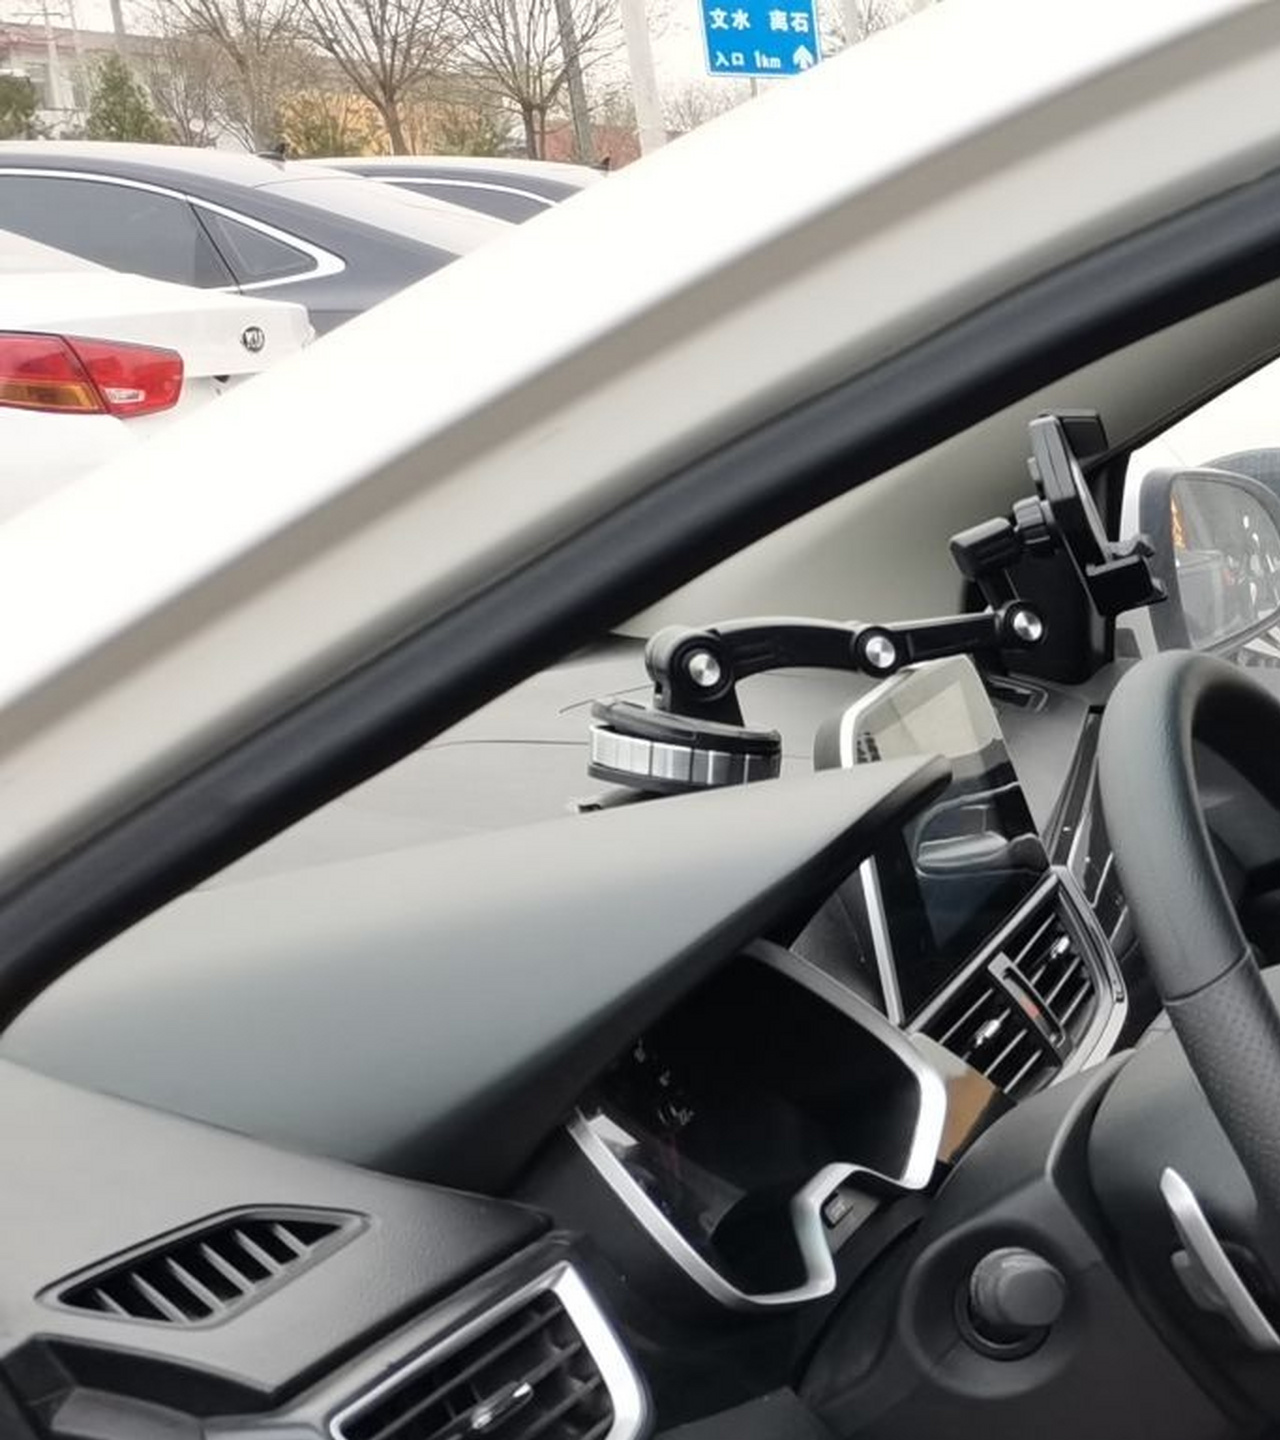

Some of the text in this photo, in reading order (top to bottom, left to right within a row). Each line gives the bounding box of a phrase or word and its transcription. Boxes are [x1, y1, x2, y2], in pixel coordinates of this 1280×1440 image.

[709, 7, 751, 30] 文水
[715, 50, 781, 69] 入口 1km
